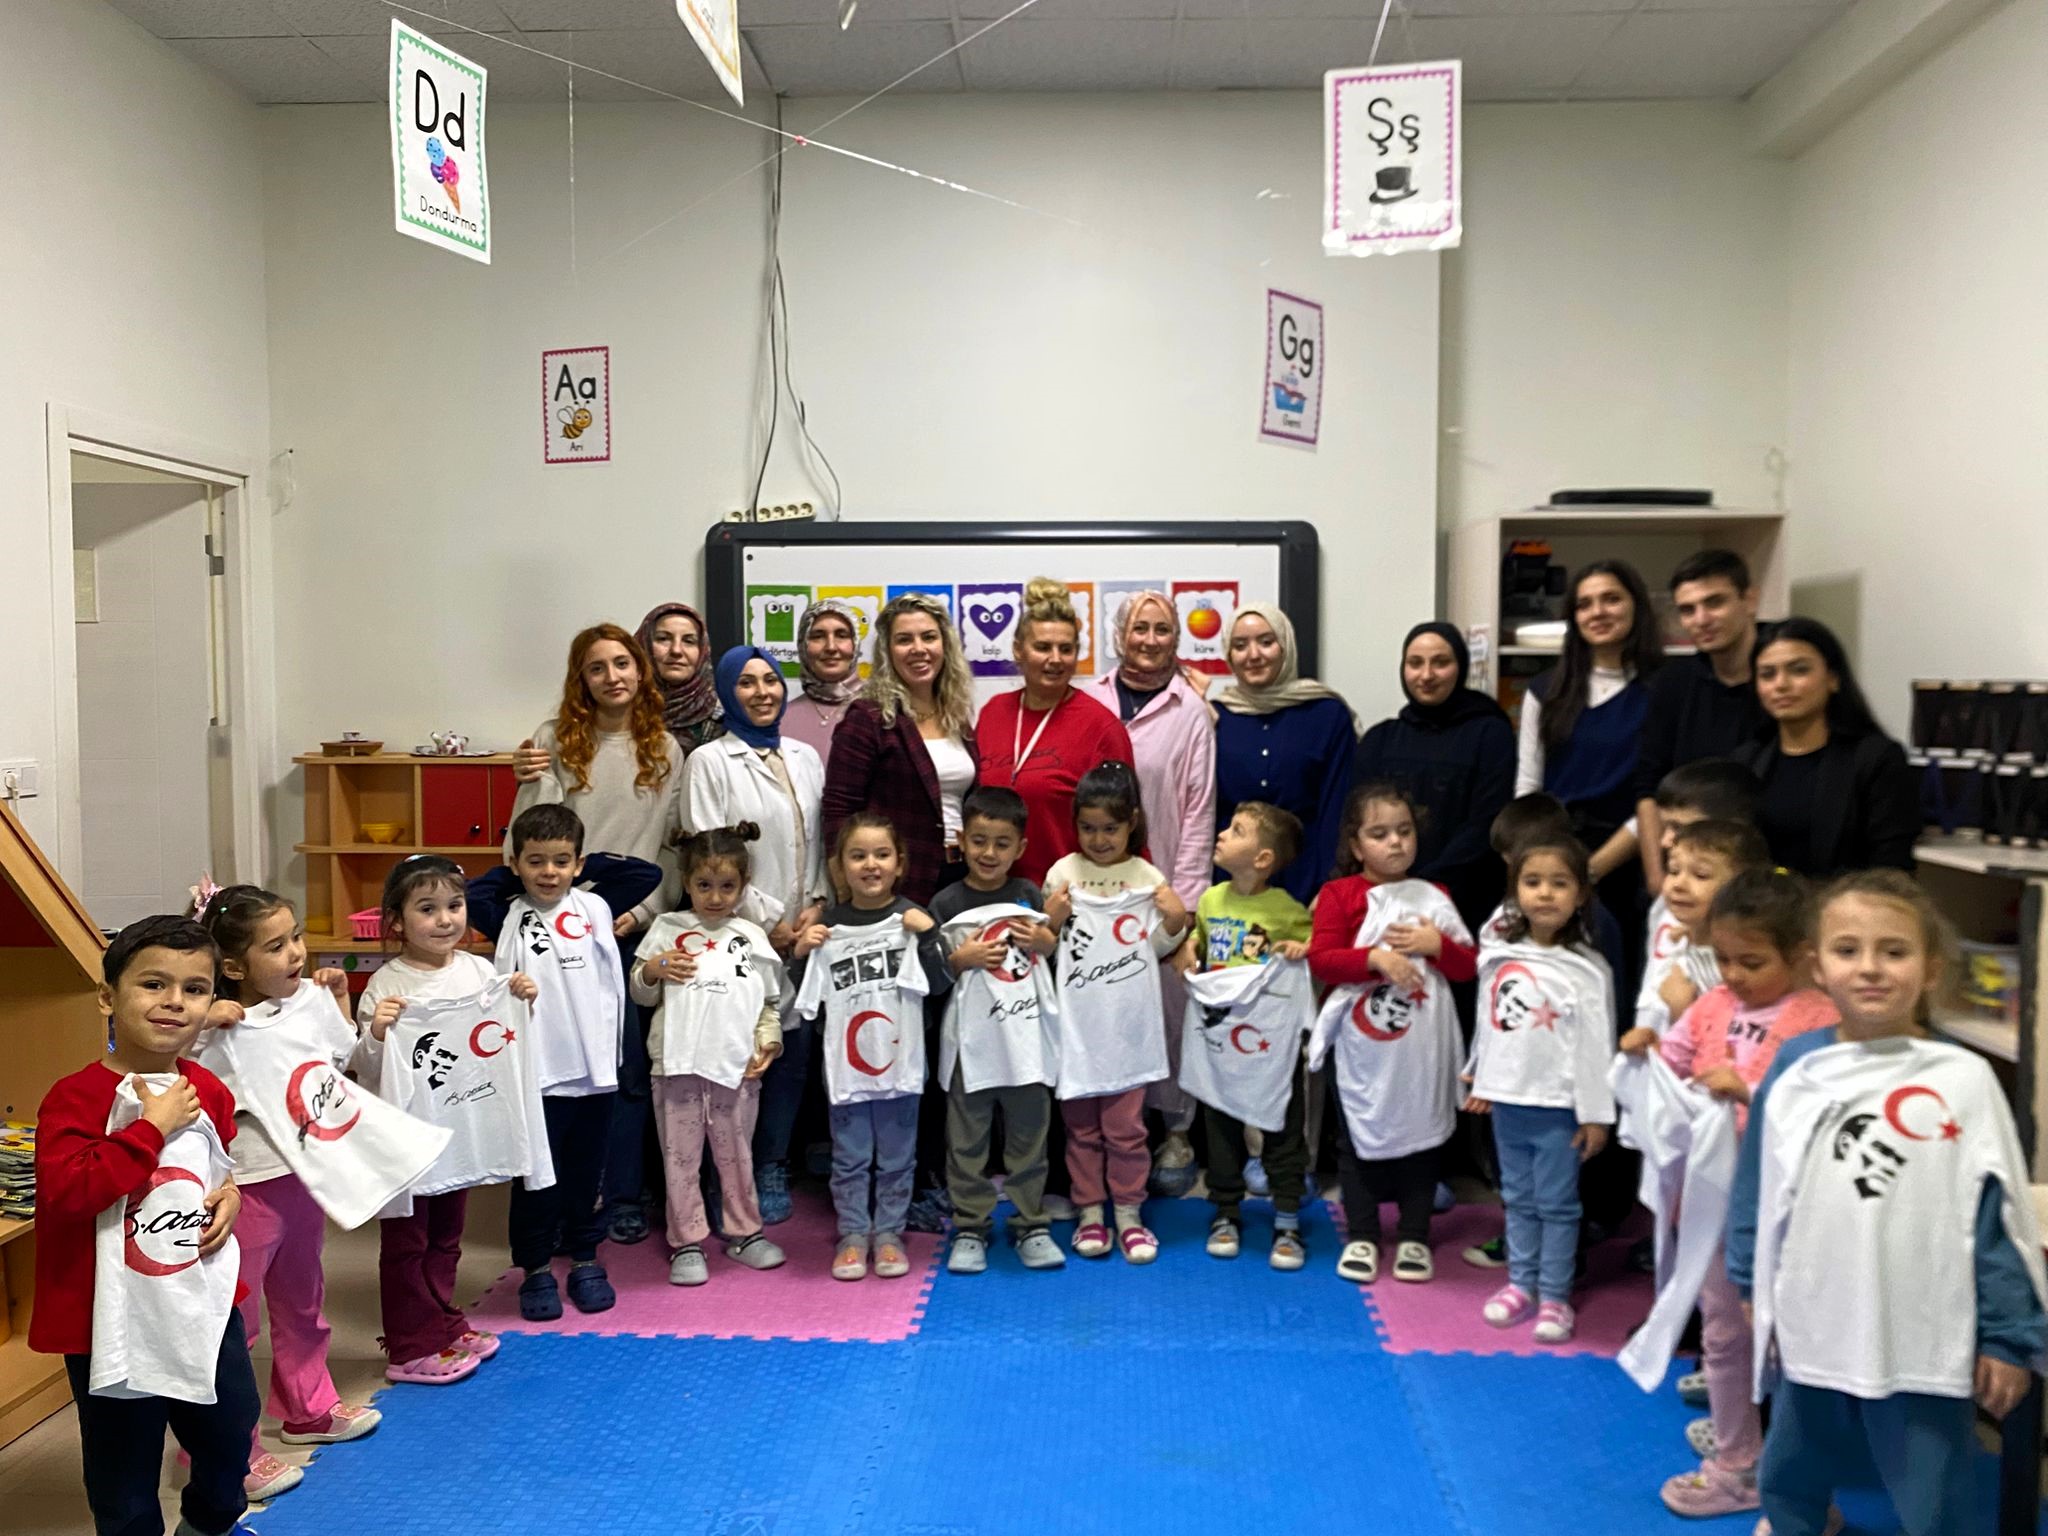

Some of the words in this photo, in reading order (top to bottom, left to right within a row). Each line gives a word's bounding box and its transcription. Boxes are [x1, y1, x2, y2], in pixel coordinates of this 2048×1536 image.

[415, 69, 466, 151] Dd
[1367, 97, 1420, 156] Şş
[420, 195, 477, 232] Dondurma
[1279, 314, 1314, 379] Gg
[554, 363, 597, 402] Aa
[768, 646, 800, 660] dörtge
